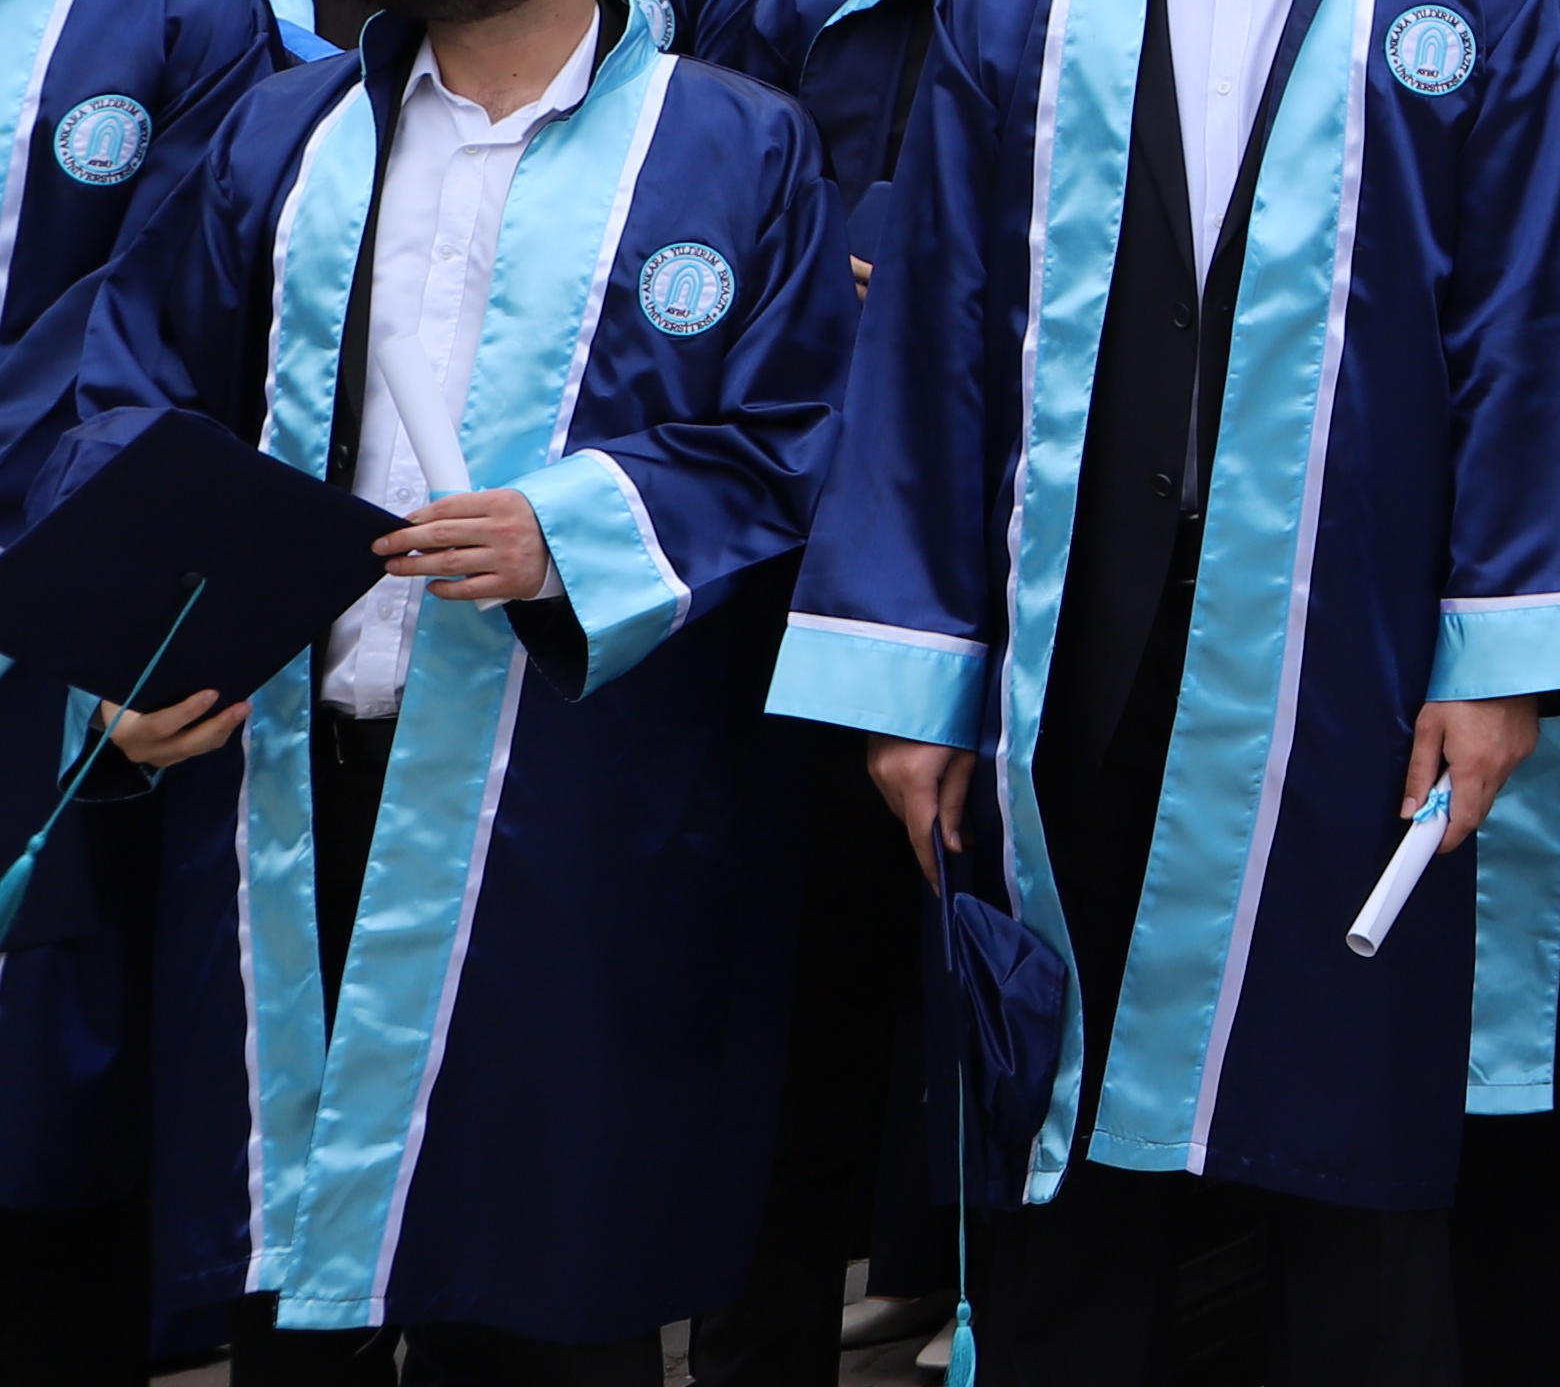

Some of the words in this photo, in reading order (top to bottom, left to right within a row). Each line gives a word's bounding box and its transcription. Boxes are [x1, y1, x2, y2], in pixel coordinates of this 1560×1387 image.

[1389, 18, 1412, 58] ANKARA
[1412, 9, 1460, 27] YILDIRIM
[59, 109, 87, 148] ANKARA
[642, 254, 668, 294] ANKARA
[671, 246, 719, 265] YILDIRIM
